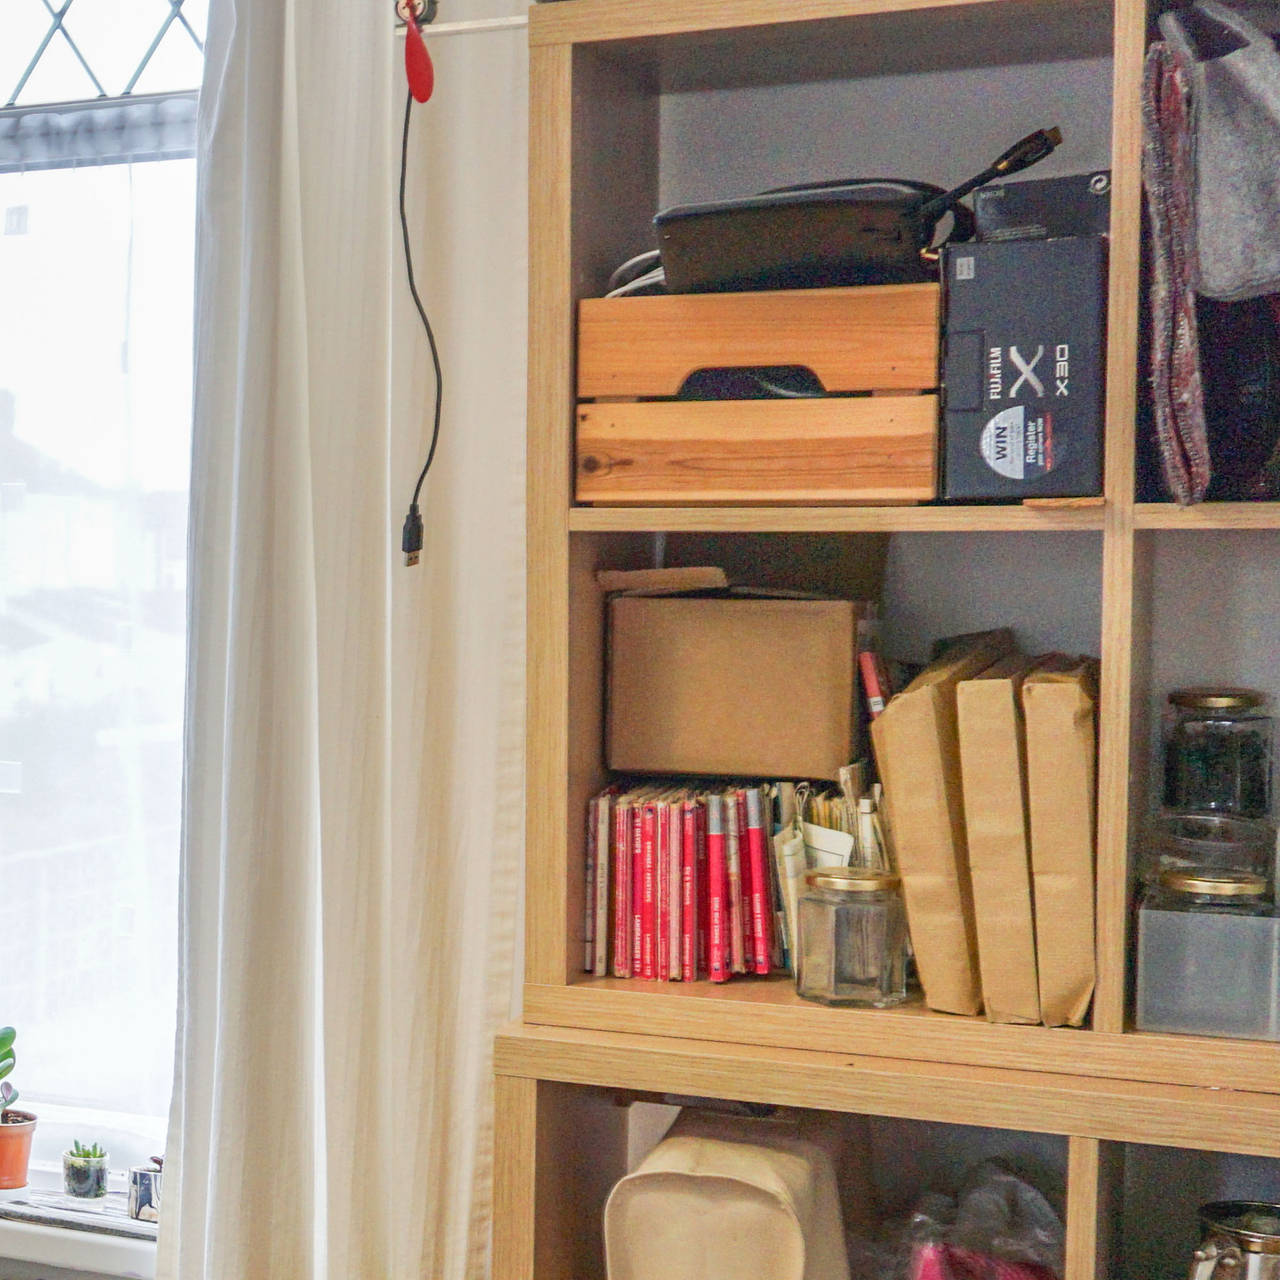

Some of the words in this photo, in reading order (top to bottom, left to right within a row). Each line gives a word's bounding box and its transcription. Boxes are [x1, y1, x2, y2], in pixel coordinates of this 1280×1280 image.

[990, 347, 1002, 400] FUJIFILM
[1055, 344, 1069, 397] X30
[996, 425, 1008, 461] WIN
[1026, 420, 1038, 464] Register
[634, 914, 642, 959] LANDRANGER
